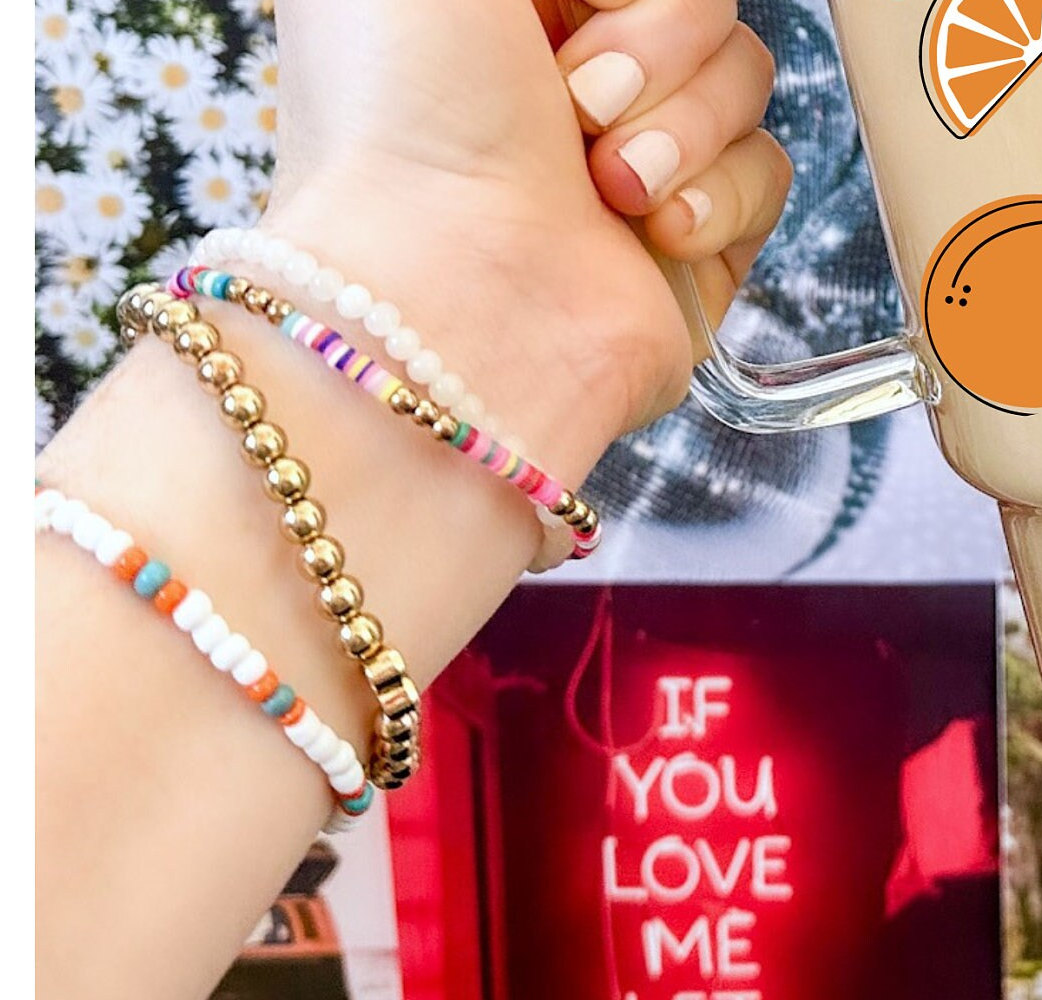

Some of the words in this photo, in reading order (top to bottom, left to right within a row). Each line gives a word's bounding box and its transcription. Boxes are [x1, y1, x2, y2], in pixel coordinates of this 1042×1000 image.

[657, 676, 731, 738] IF
[614, 752, 777, 821] YOU
[603, 835, 793, 901] LOVE
[642, 908, 760, 980] ME
